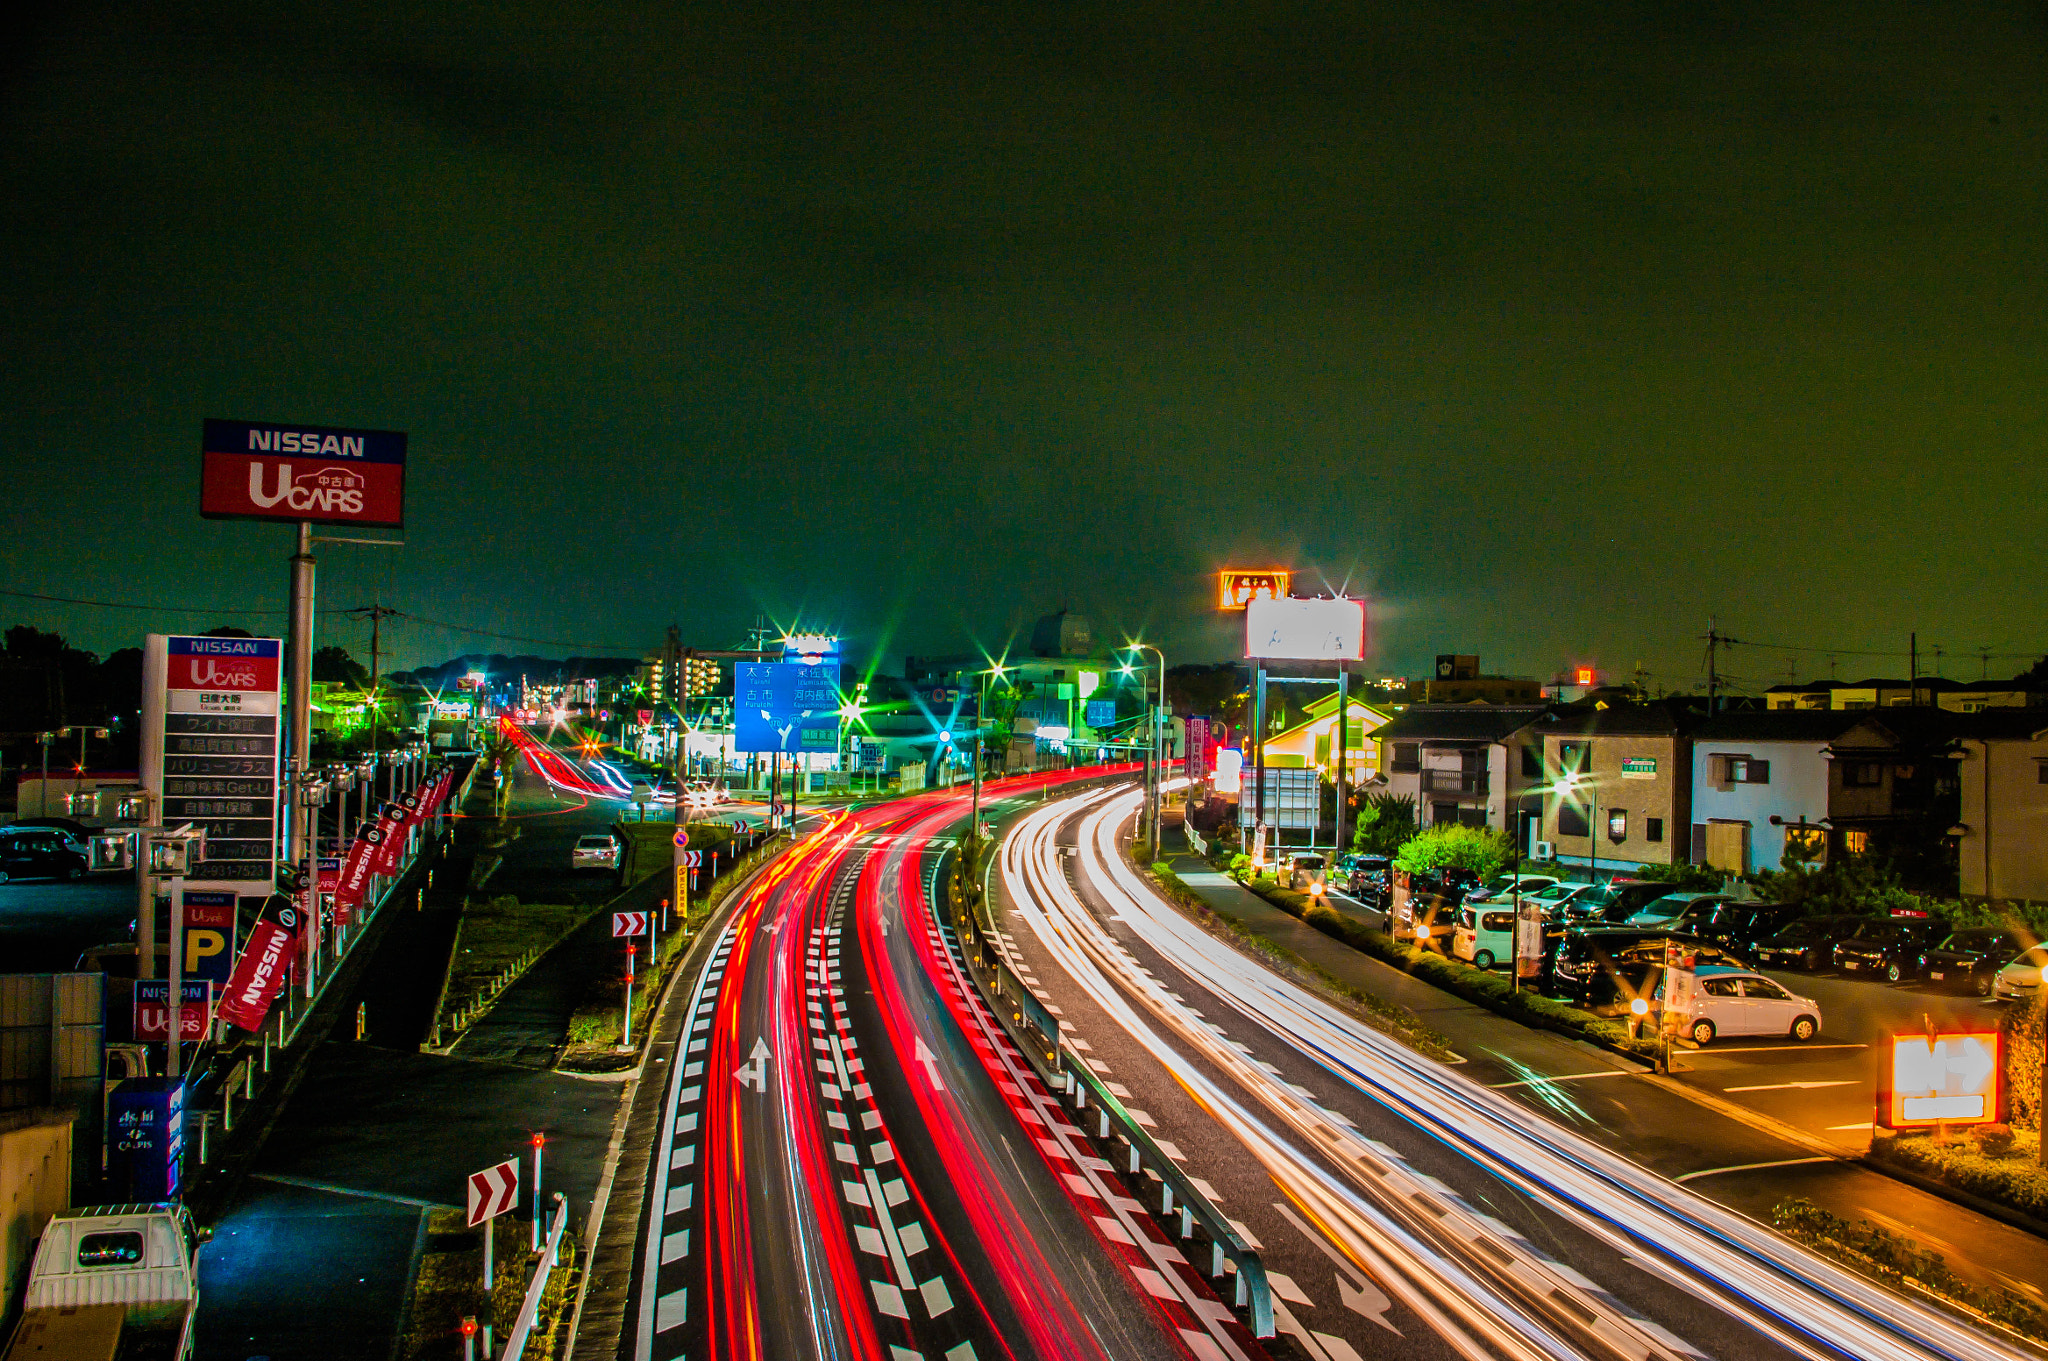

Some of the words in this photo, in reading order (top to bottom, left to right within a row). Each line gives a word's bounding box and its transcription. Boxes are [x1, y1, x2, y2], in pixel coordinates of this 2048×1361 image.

[249, 429, 364, 457] NISSAN
[318, 475, 355, 487] 中古車
[191, 641, 258, 654] NISSAN
[746, 666, 773, 678] 太子
[797, 667, 834, 678] 泉佐野
[200, 694, 242, 704] 日産大阪
[747, 689, 773, 701] 古市
[794, 689, 835, 701] 河内長野
[184, 802, 254, 815] 自動車保険
[348, 844, 375, 891] NISSAN
[185, 929, 225, 973] P
[241, 929, 289, 1006] NISSAN
[142, 987, 202, 998] NISAN
